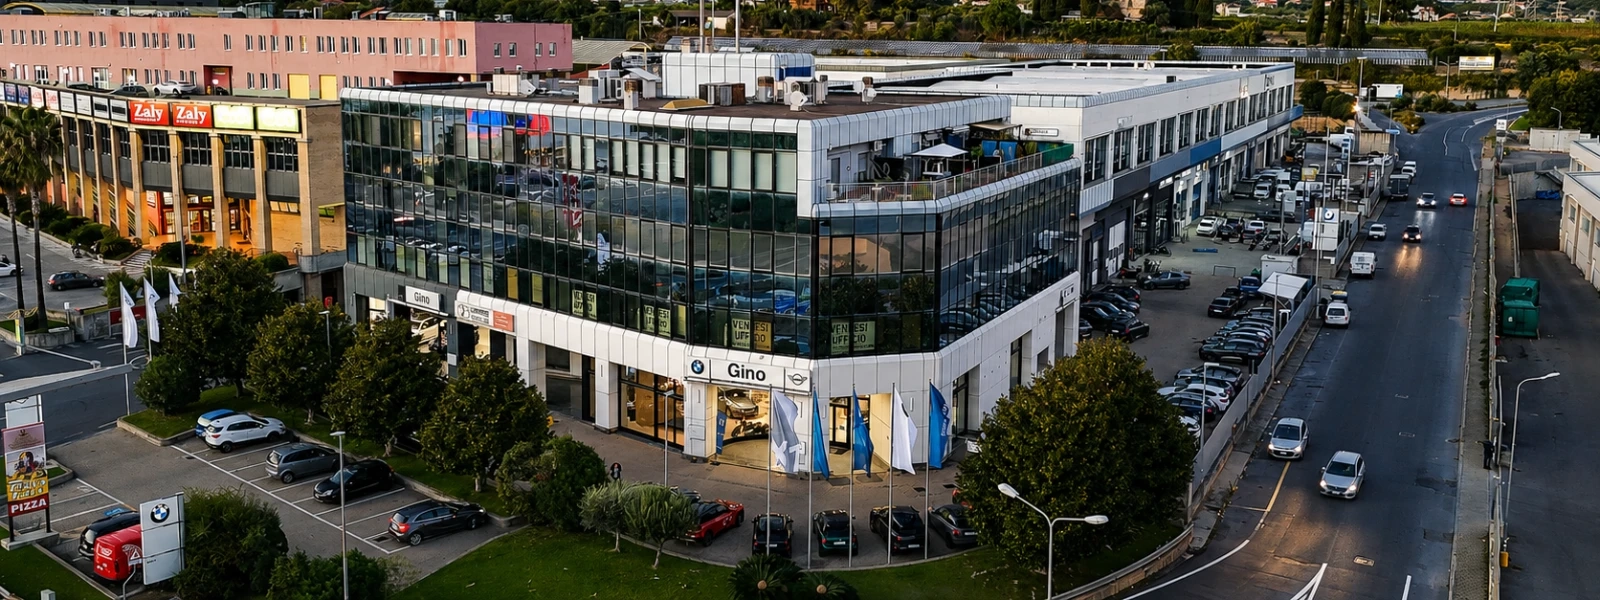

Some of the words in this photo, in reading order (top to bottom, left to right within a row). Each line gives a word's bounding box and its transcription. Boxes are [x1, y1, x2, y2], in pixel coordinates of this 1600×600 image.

[134, 103, 163, 122] Zaly
[176, 105, 207, 124] Zaly
[413, 291, 430, 305] Gino
[732, 320, 768, 332] VENESI
[831, 323, 868, 334] VENESI
[832, 334, 866, 345] UFFCIO
[727, 362, 766, 382] Gino
[11, 498, 47, 514] PIZZA
